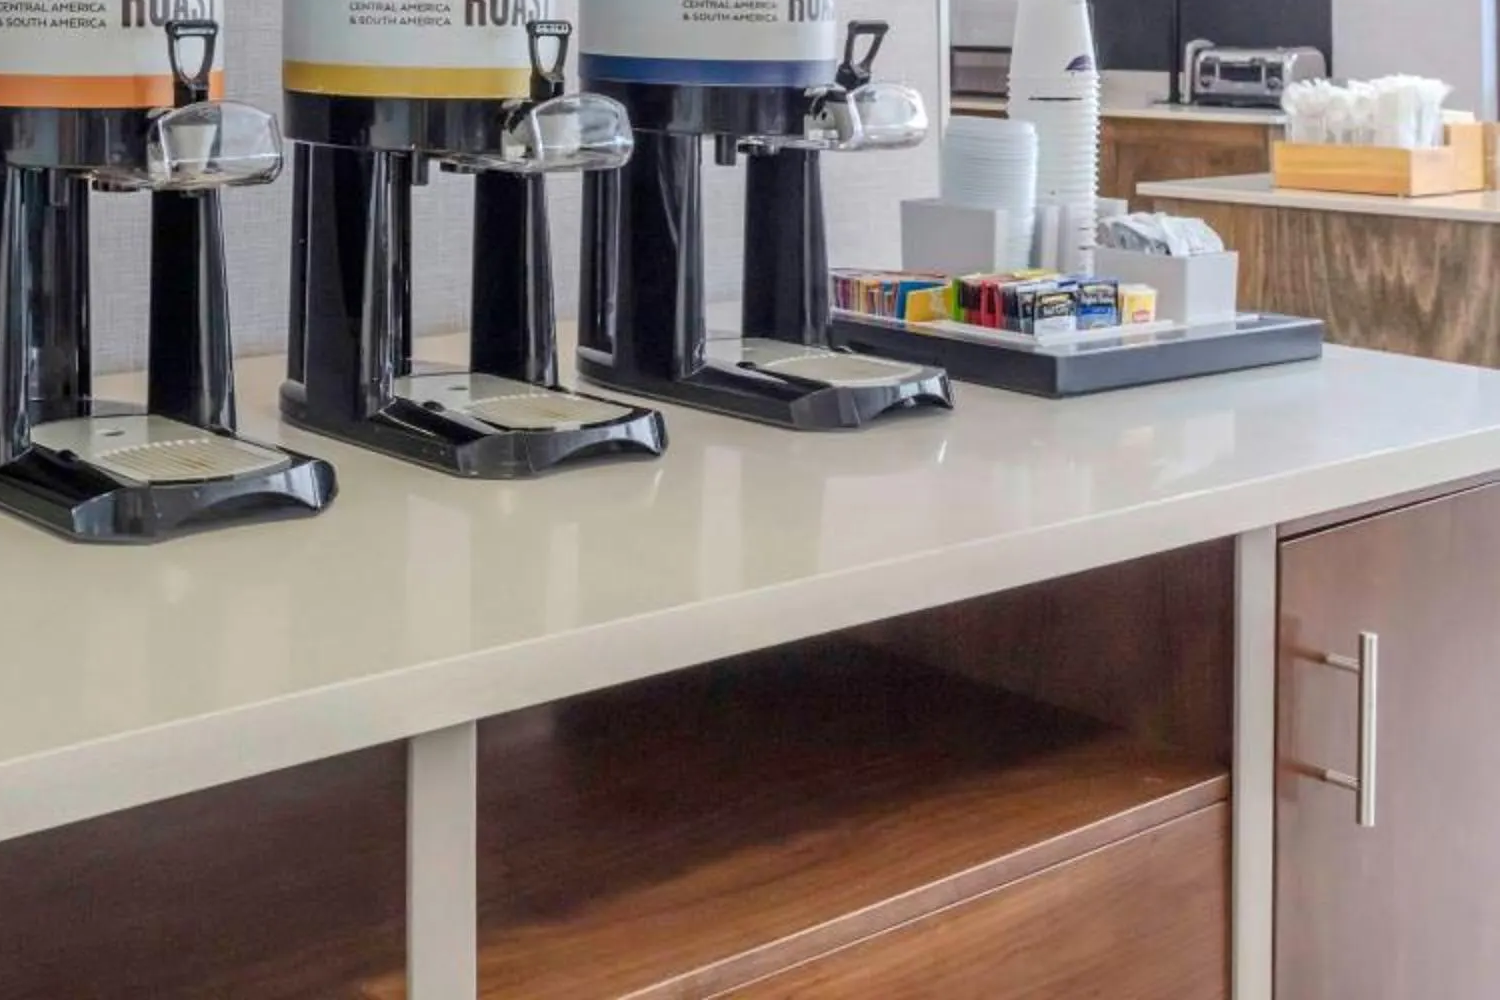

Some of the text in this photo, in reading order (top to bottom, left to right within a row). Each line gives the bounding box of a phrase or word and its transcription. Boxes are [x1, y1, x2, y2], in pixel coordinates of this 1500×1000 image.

[50, 2, 106, 13] AMERICA
[350, 2, 451, 13] CENTRAL AMERICA
[683, 0, 777, 9] CENTRAL AMERICA
[359, 16, 397, 26] SOUTH
[400, 17, 451, 26] AMERICA
[692, 12, 730, 22] SOUTH
[733, 13, 778, 22] AMERICA
[5, 17, 47, 28] SOUTH
[50, 18, 106, 29] AMERICA
